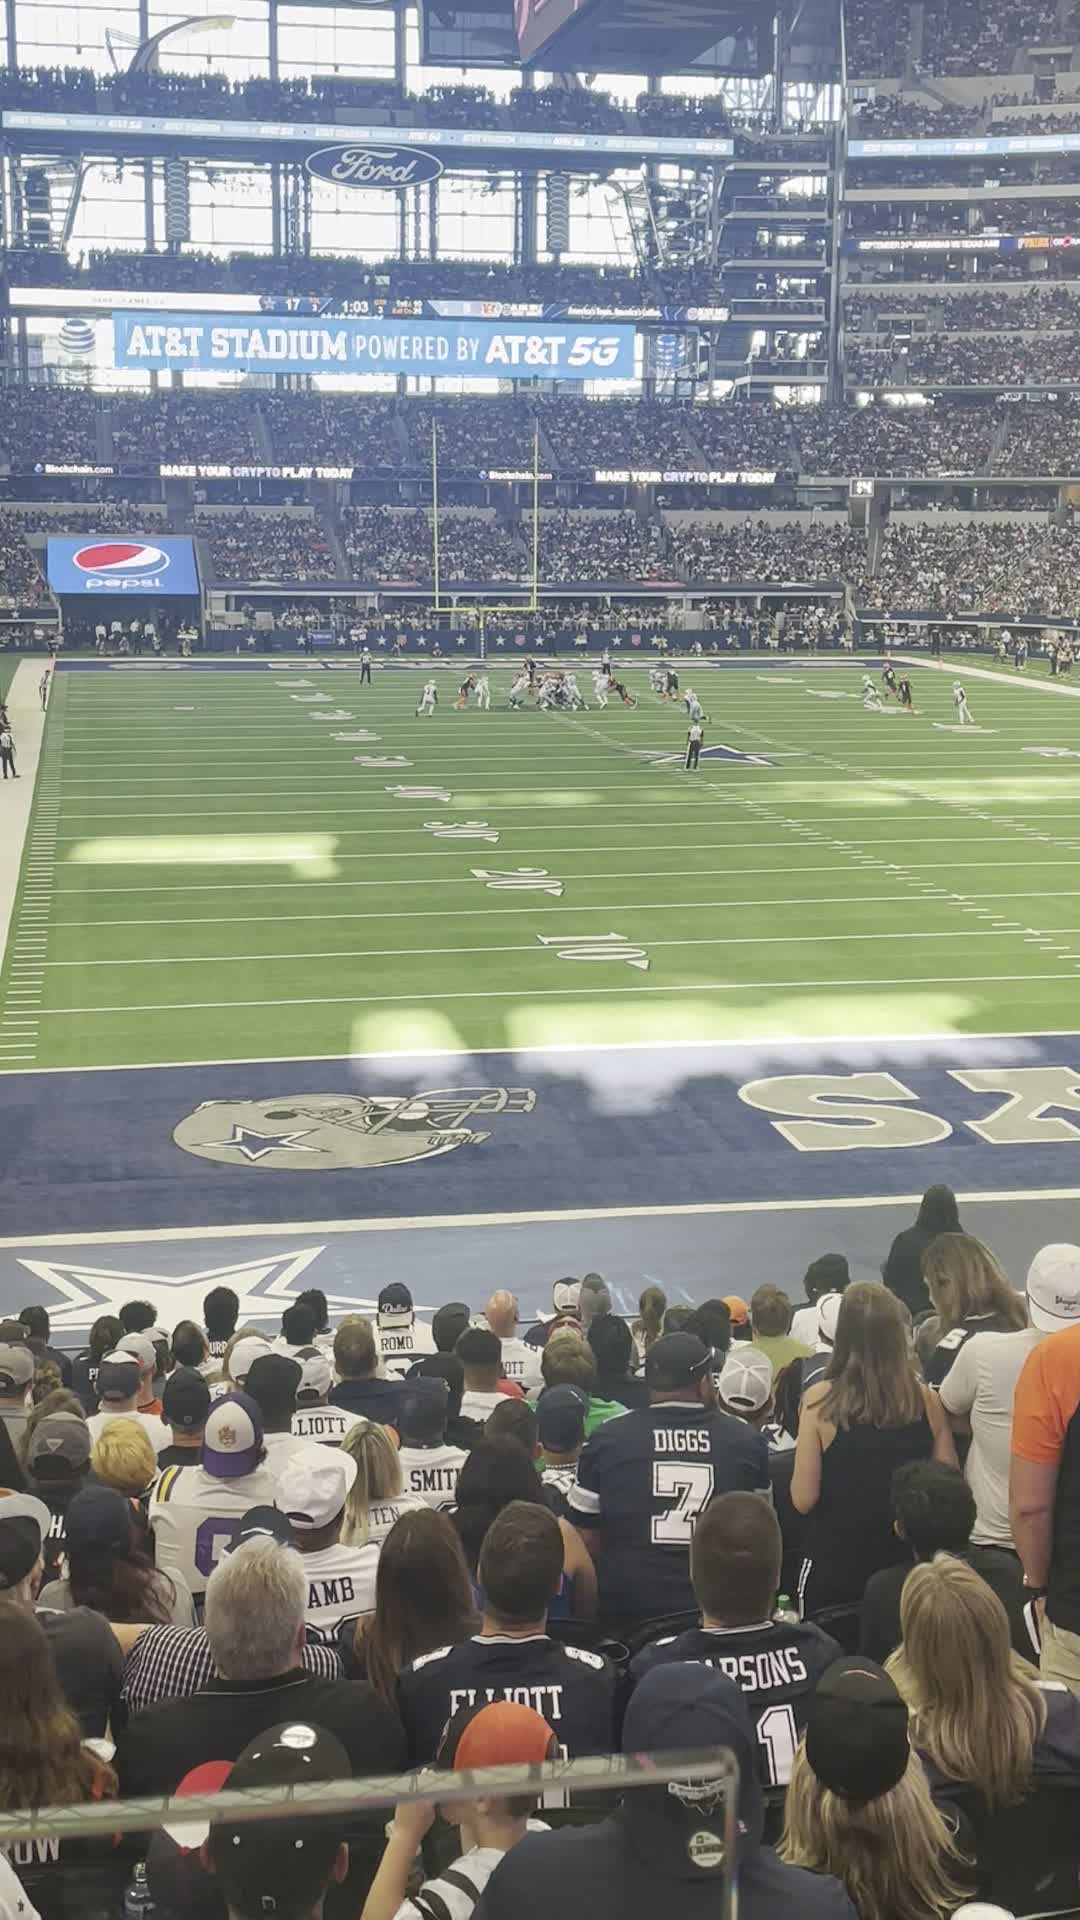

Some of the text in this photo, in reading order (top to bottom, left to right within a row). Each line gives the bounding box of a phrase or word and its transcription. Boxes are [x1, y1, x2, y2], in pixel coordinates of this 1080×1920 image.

[331, 149, 418, 182] Ford
[286, 299, 300, 310] 17
[341, 301, 369, 313] 1:03
[126, 325, 621, 367] AT&T STADIUM POWERED BY AT&T 5G
[45, 463, 114, 474] Blockchain.com
[160, 465, 354, 479] MAKE YOUR CRYPTO PLAY TODAY
[489, 470, 553, 480] Blockchain.com
[595, 471, 777, 483] MAKE YOUR CRYPTO PLAY TODAY
[86, 578, 161, 589] pepsi
[536, 932, 648, 961] 10
[381, 1336, 414, 1350] ROMO
[293, 1417, 347, 1436] LIOTT
[653, 1429, 711, 1453] DIGGS
[651, 1460, 715, 1545] 7
[49, 1514, 67, 1538] H
[307, 1576, 355, 1609] AMB
[684, 1646, 808, 1692] RSONS
